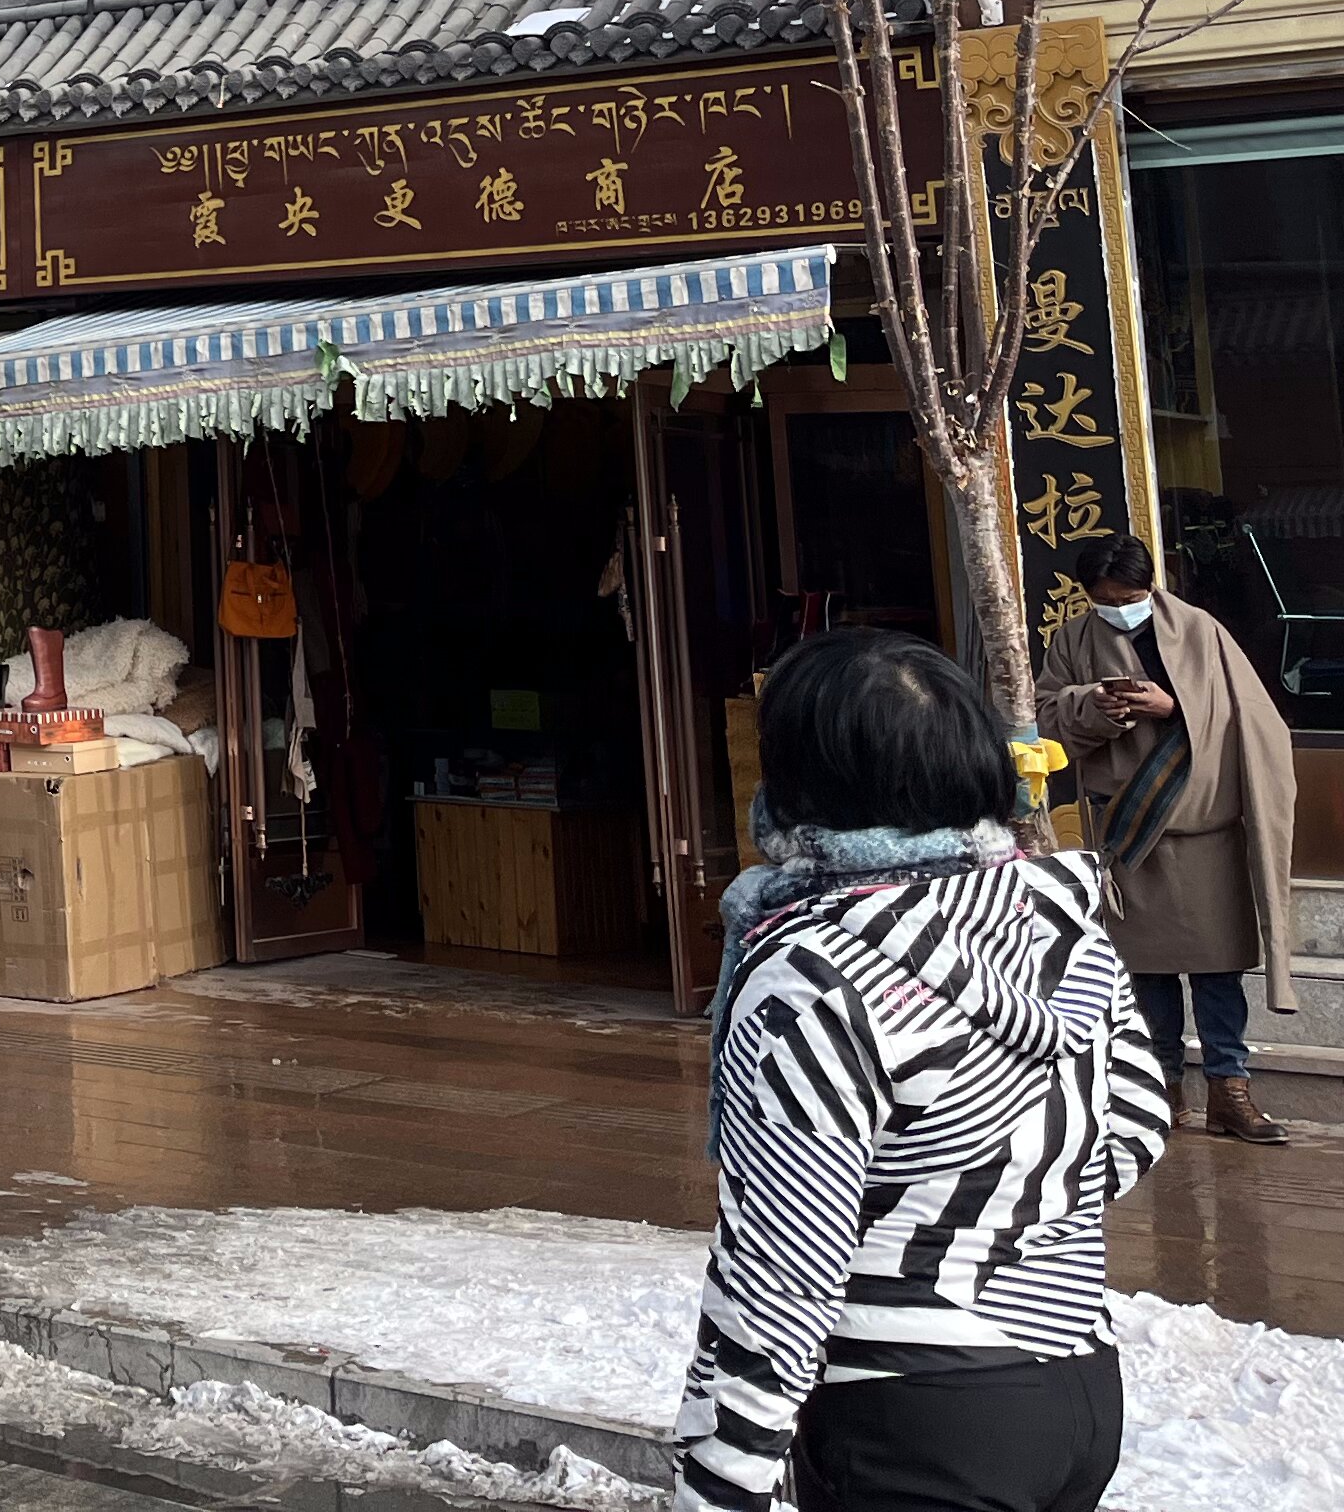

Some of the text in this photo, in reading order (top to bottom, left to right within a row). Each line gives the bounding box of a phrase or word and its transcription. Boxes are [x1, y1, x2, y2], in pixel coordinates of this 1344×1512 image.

[189, 145, 745, 249] 霞央更德商店
[687, 198, 864, 231] 1362931969
